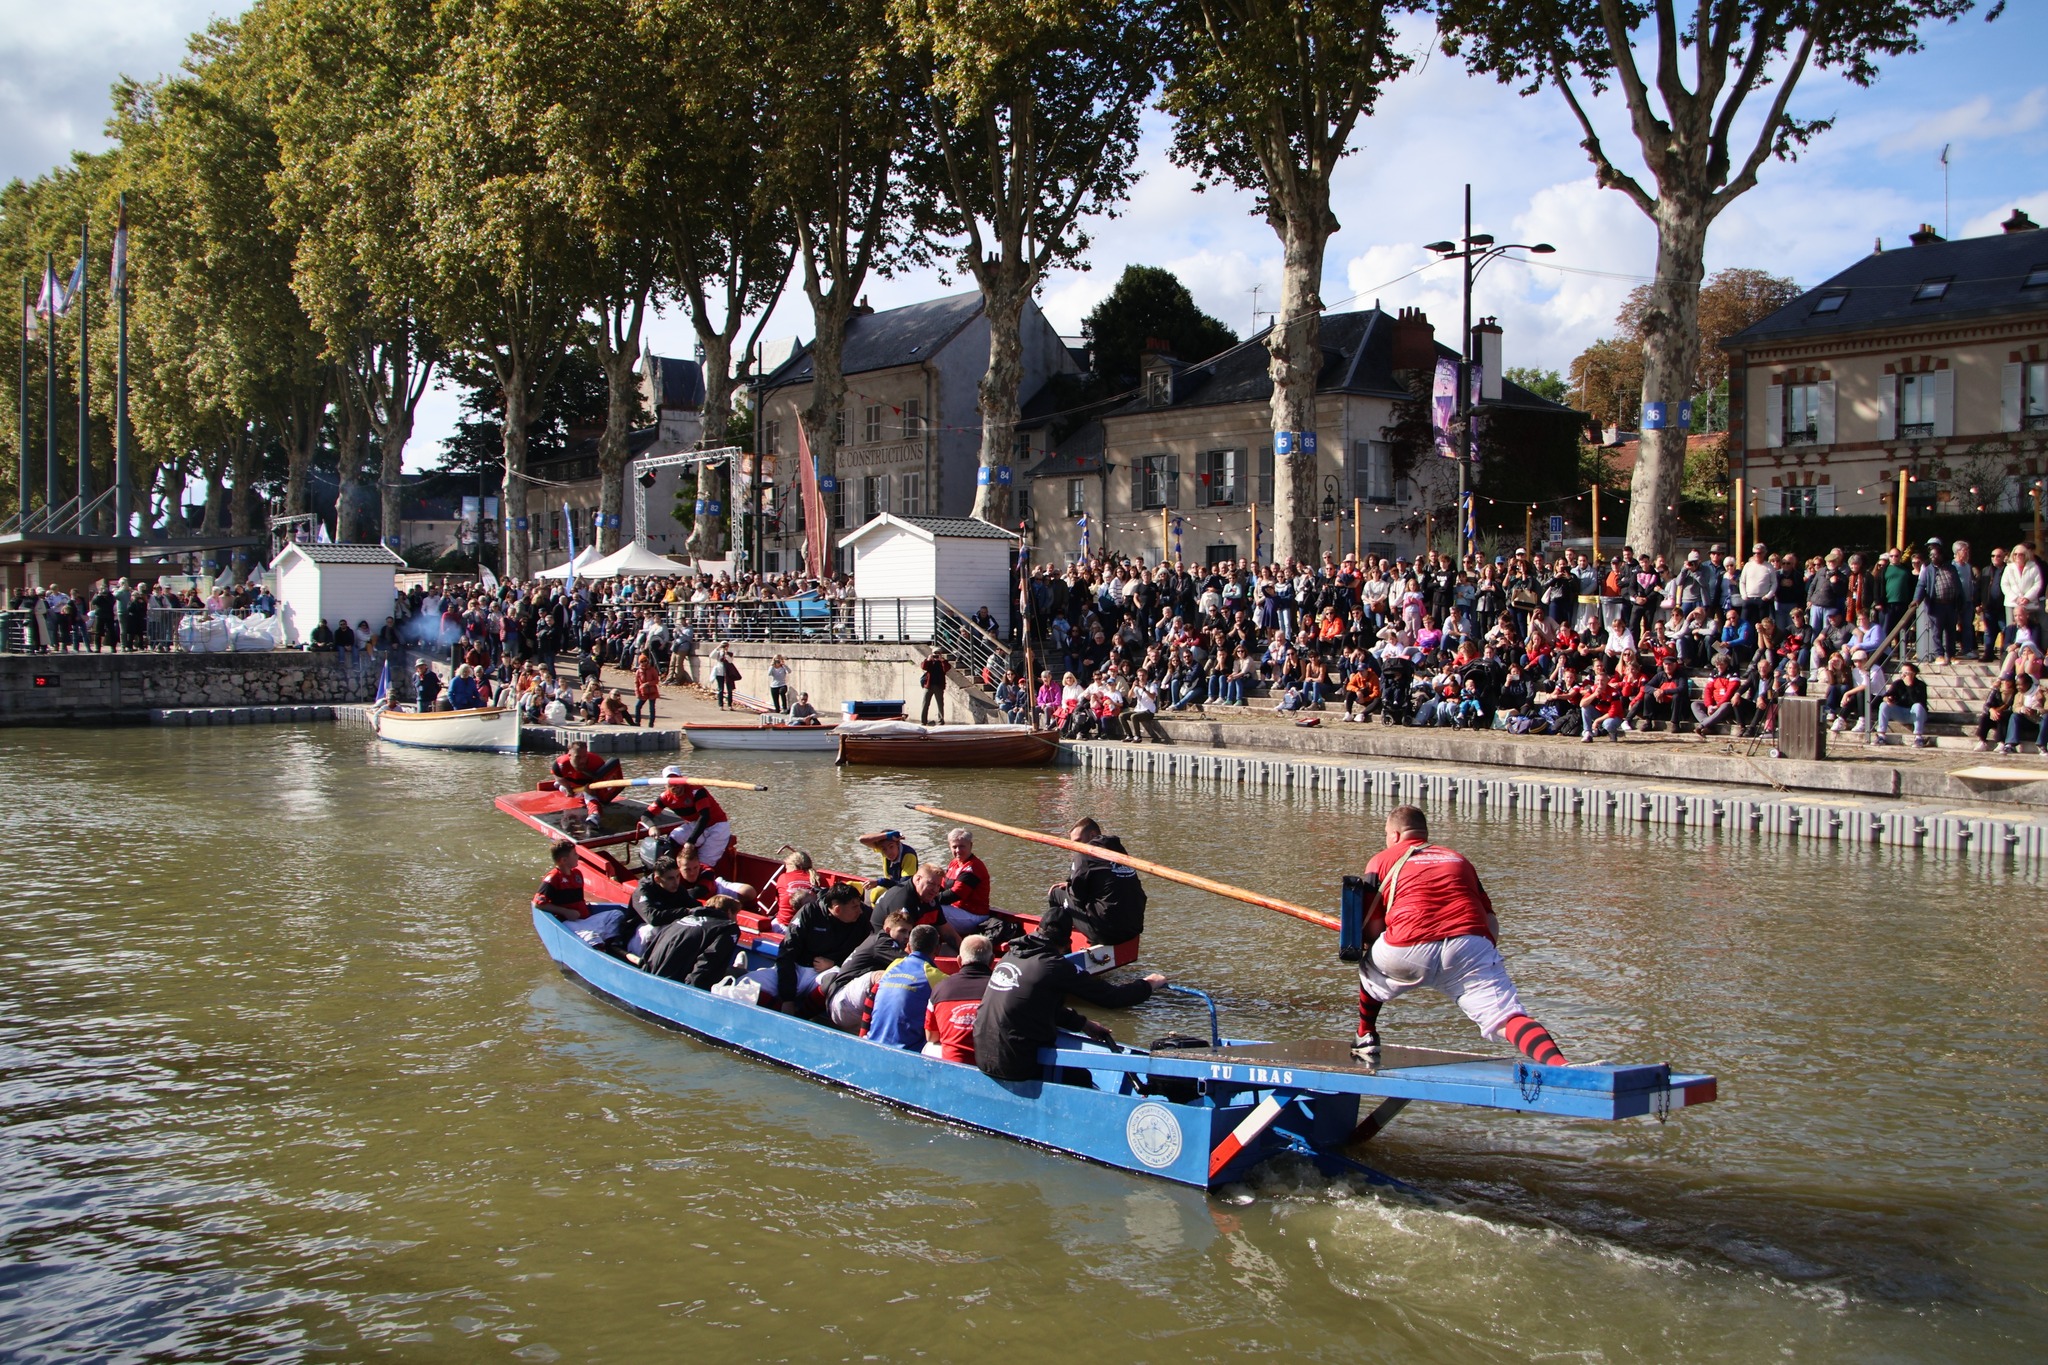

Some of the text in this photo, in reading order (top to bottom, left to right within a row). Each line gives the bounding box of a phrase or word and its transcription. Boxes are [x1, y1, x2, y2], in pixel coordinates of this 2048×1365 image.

[1647, 409, 1659, 421] 86
[1277, 437, 1287, 448] 85
[1304, 437, 1315, 448] 85
[847, 444, 923, 467] CONSTRUCTIONS
[1000, 471, 1009, 479] 84
[823, 480, 833, 488] 83
[61, 563, 101, 572] ACCUEIL
[1211, 1065, 1292, 1084] TU IRAS
